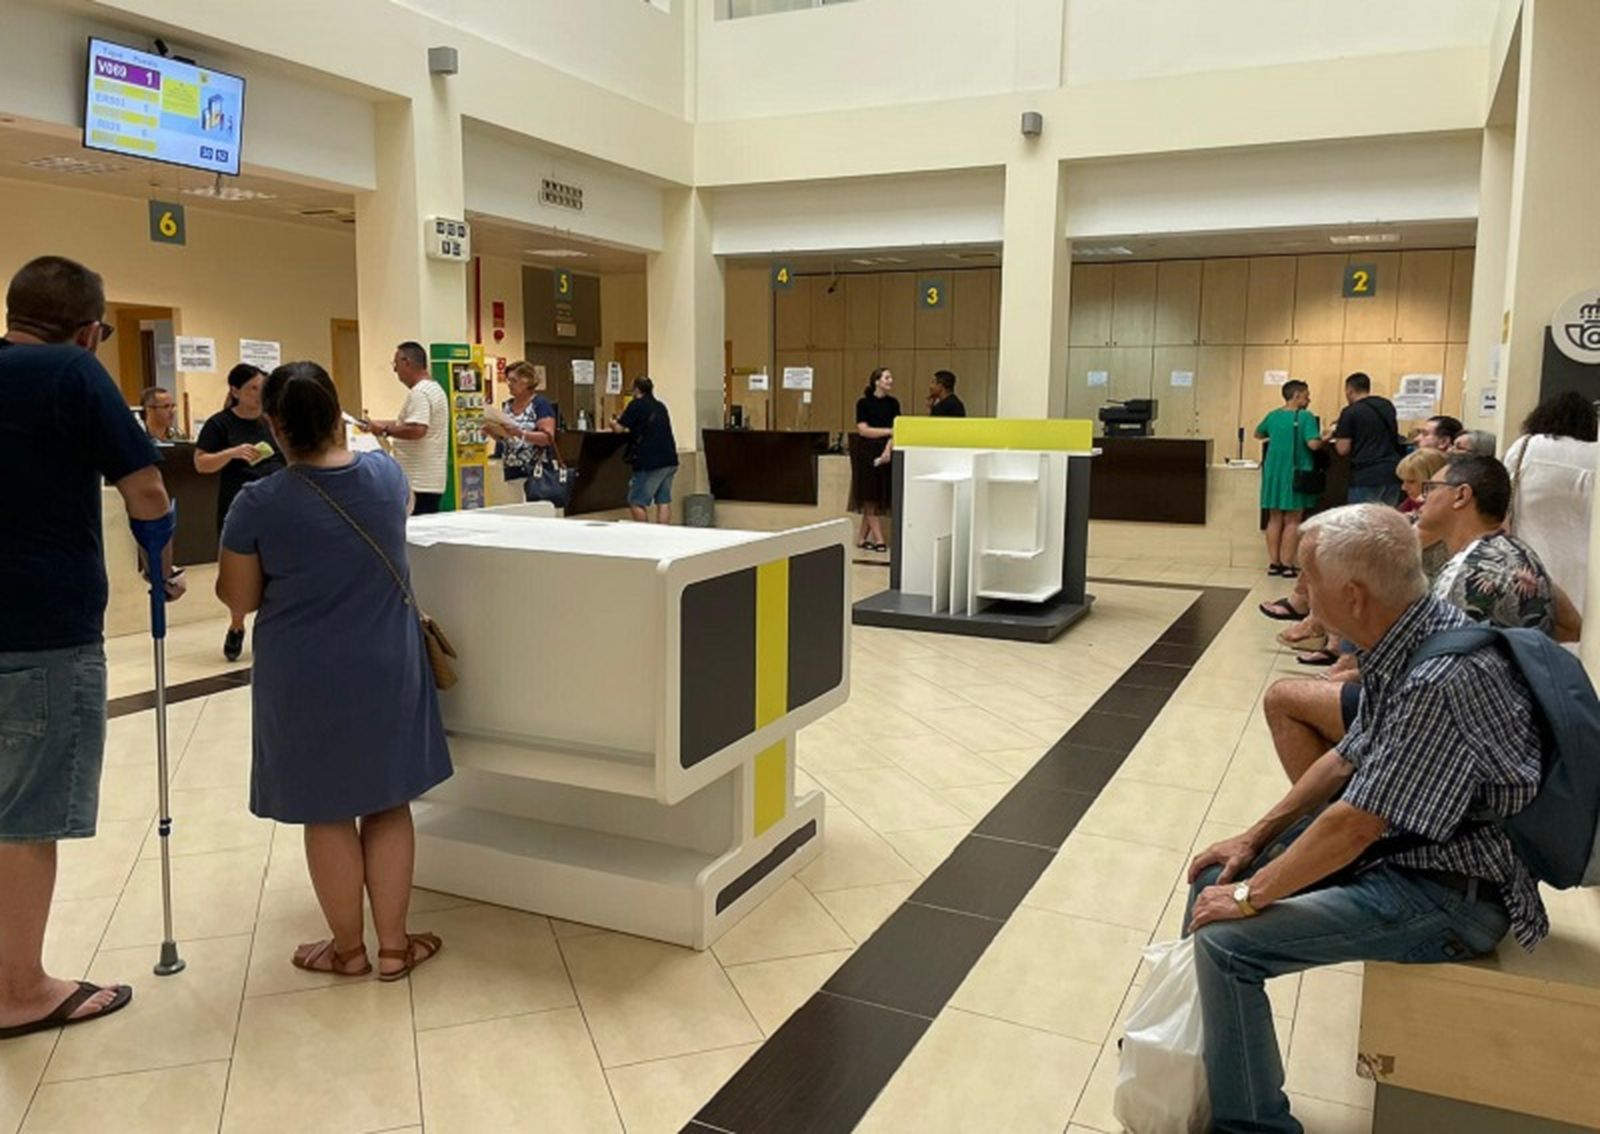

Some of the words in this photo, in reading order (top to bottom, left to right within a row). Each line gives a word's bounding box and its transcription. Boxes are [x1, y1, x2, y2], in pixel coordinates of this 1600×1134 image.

[145, 71, 153, 86] 1
[159, 211, 177, 237] 6
[559, 274, 568, 294] 5
[777, 267, 788, 284] 4
[1352, 270, 1369, 292] 2
[926, 287, 939, 305] 3
